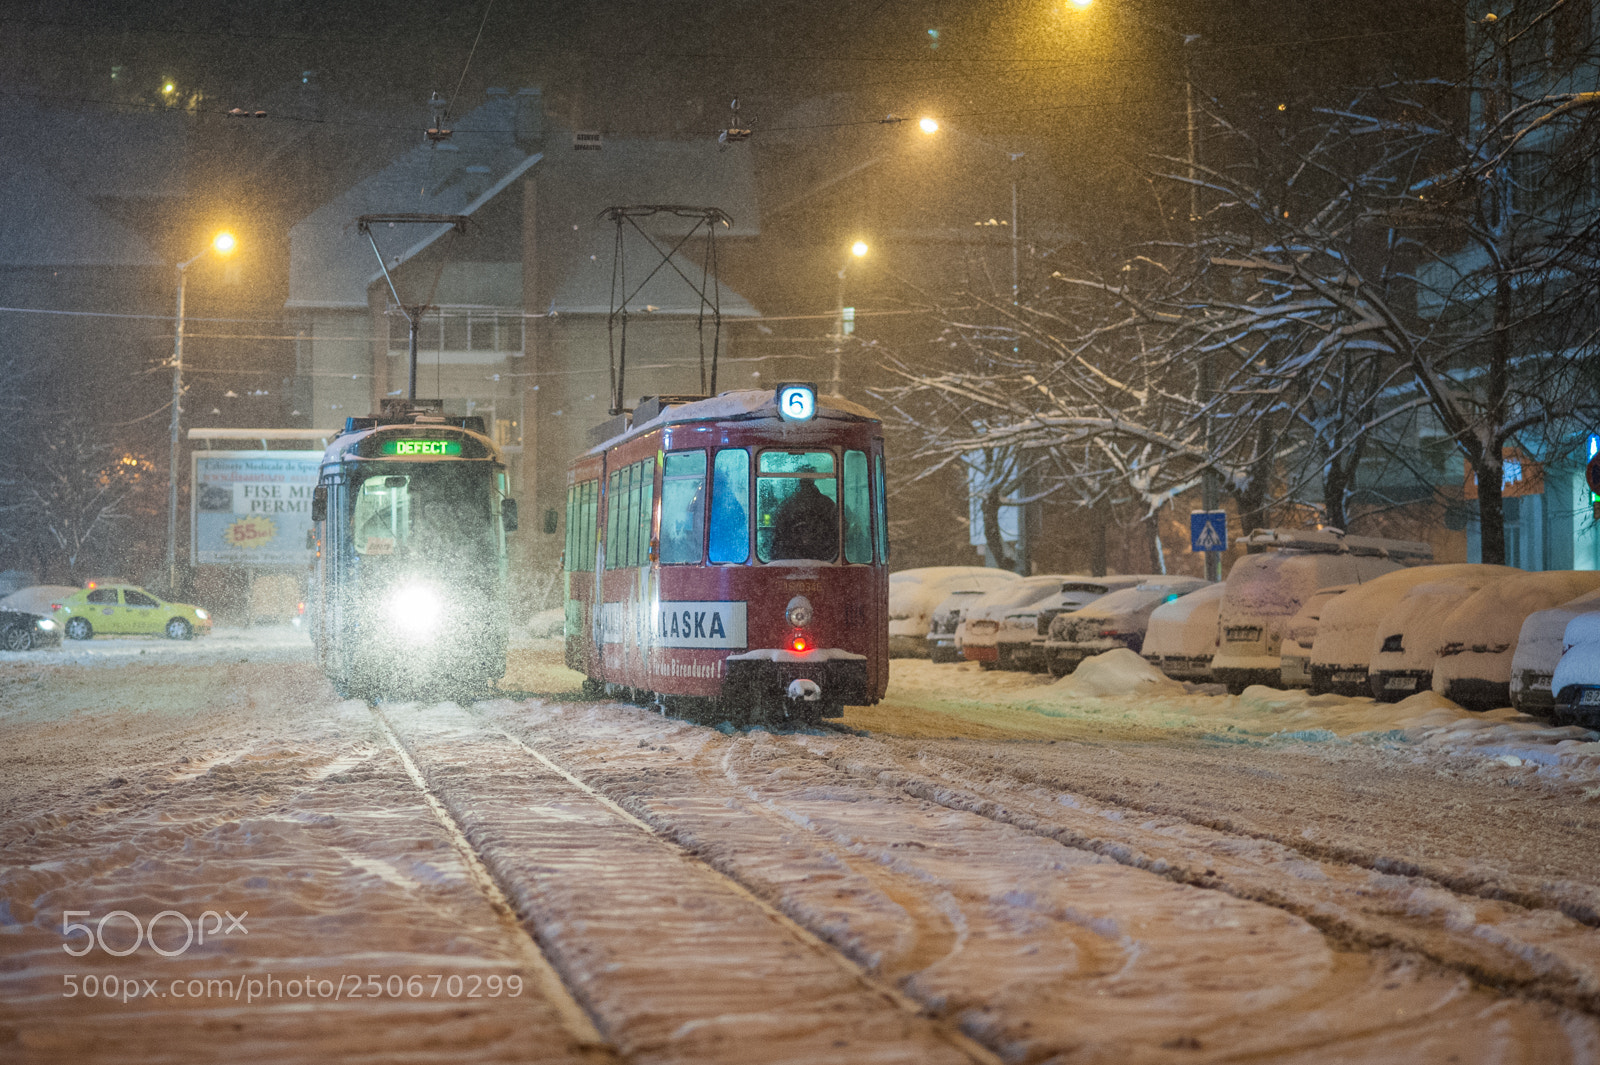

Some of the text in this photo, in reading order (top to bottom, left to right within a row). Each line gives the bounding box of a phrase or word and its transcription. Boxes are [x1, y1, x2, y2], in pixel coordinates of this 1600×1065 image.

[789, 392, 804, 416] 6
[396, 441, 448, 455] DEFECT
[297, 461, 316, 473] Spec
[244, 485, 282, 498] FISE
[251, 501, 309, 513] PERMI
[657, 610, 727, 639] LASKA
